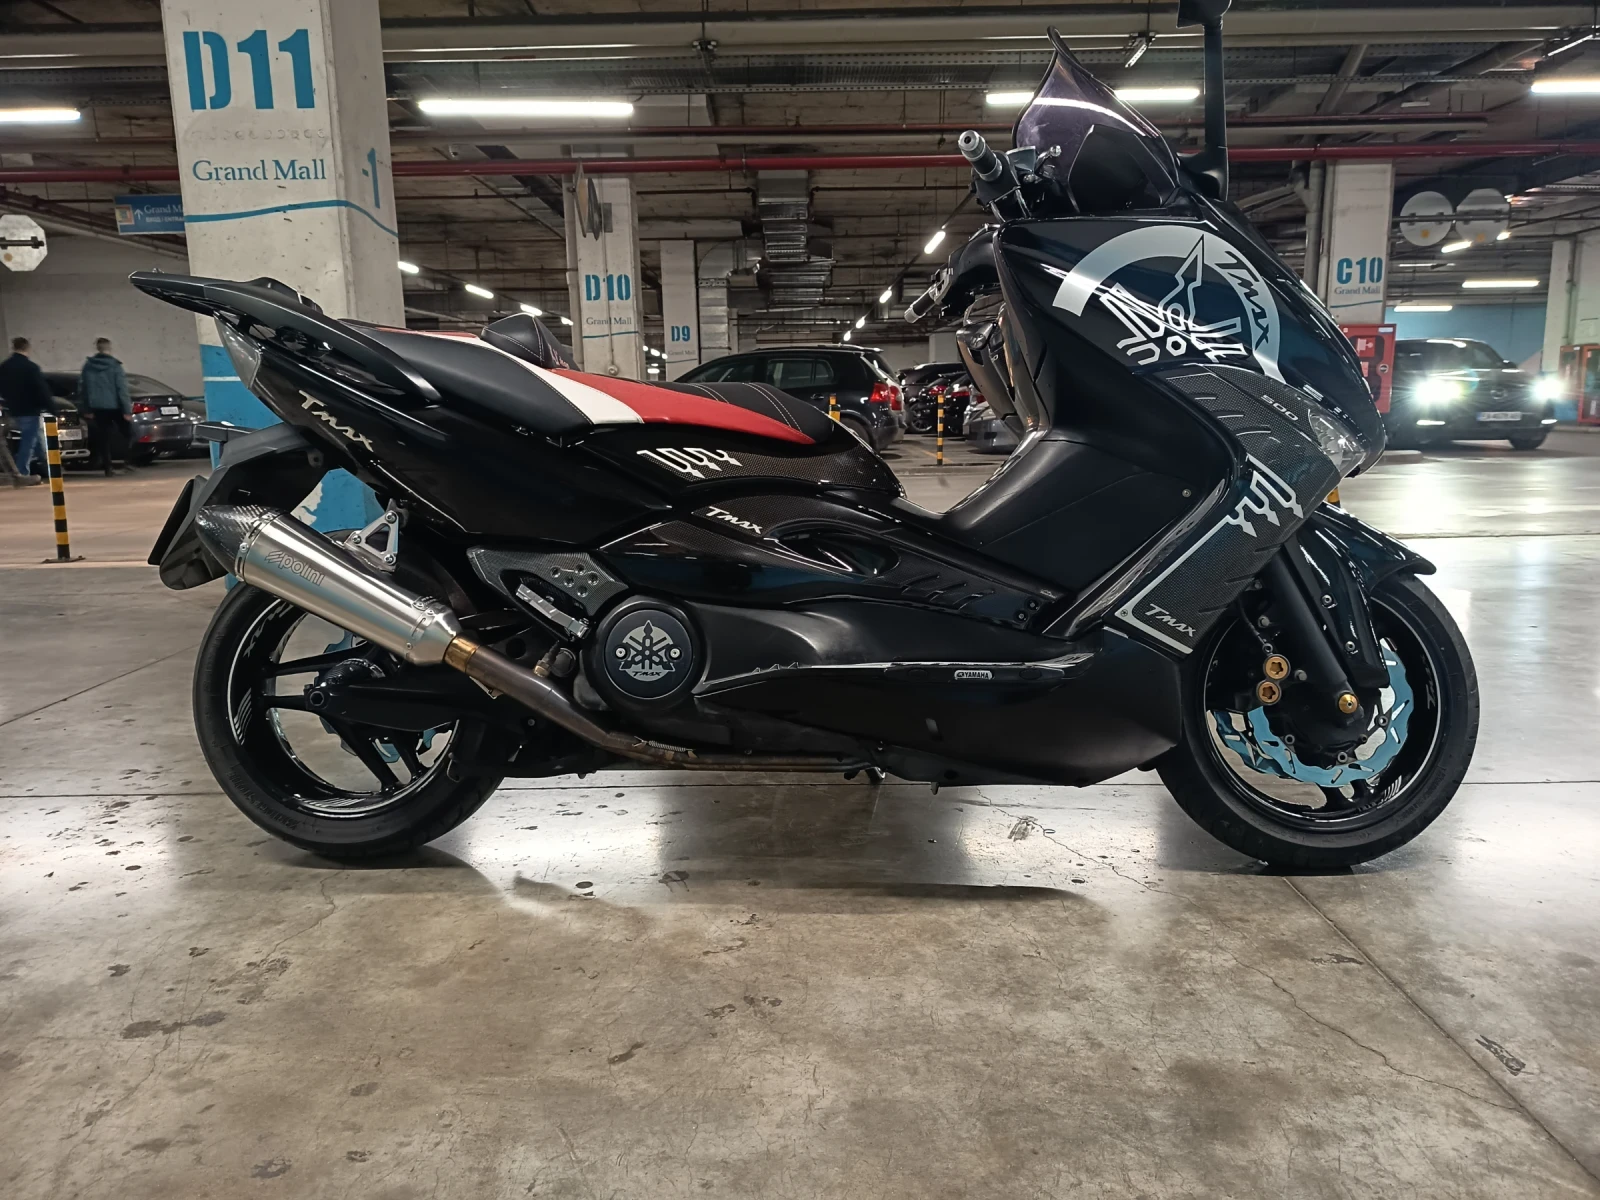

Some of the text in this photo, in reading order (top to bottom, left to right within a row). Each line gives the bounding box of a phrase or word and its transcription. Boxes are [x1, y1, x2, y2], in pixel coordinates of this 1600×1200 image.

[183, 29, 315, 110] D11
[192, 158, 327, 181] Grand Mall
[144, 204, 184, 214] Grand M
[1336, 256, 1383, 285] C10
[585, 274, 631, 301] D10
[1334, 285, 1381, 295] Grand Mall
[586, 317, 632, 325] Grand Mall
[671, 325, 690, 342] D9
[1261, 394, 1299, 421] 500
[278, 552, 326, 587] polini
[964, 670, 990, 679] YAMAHA
